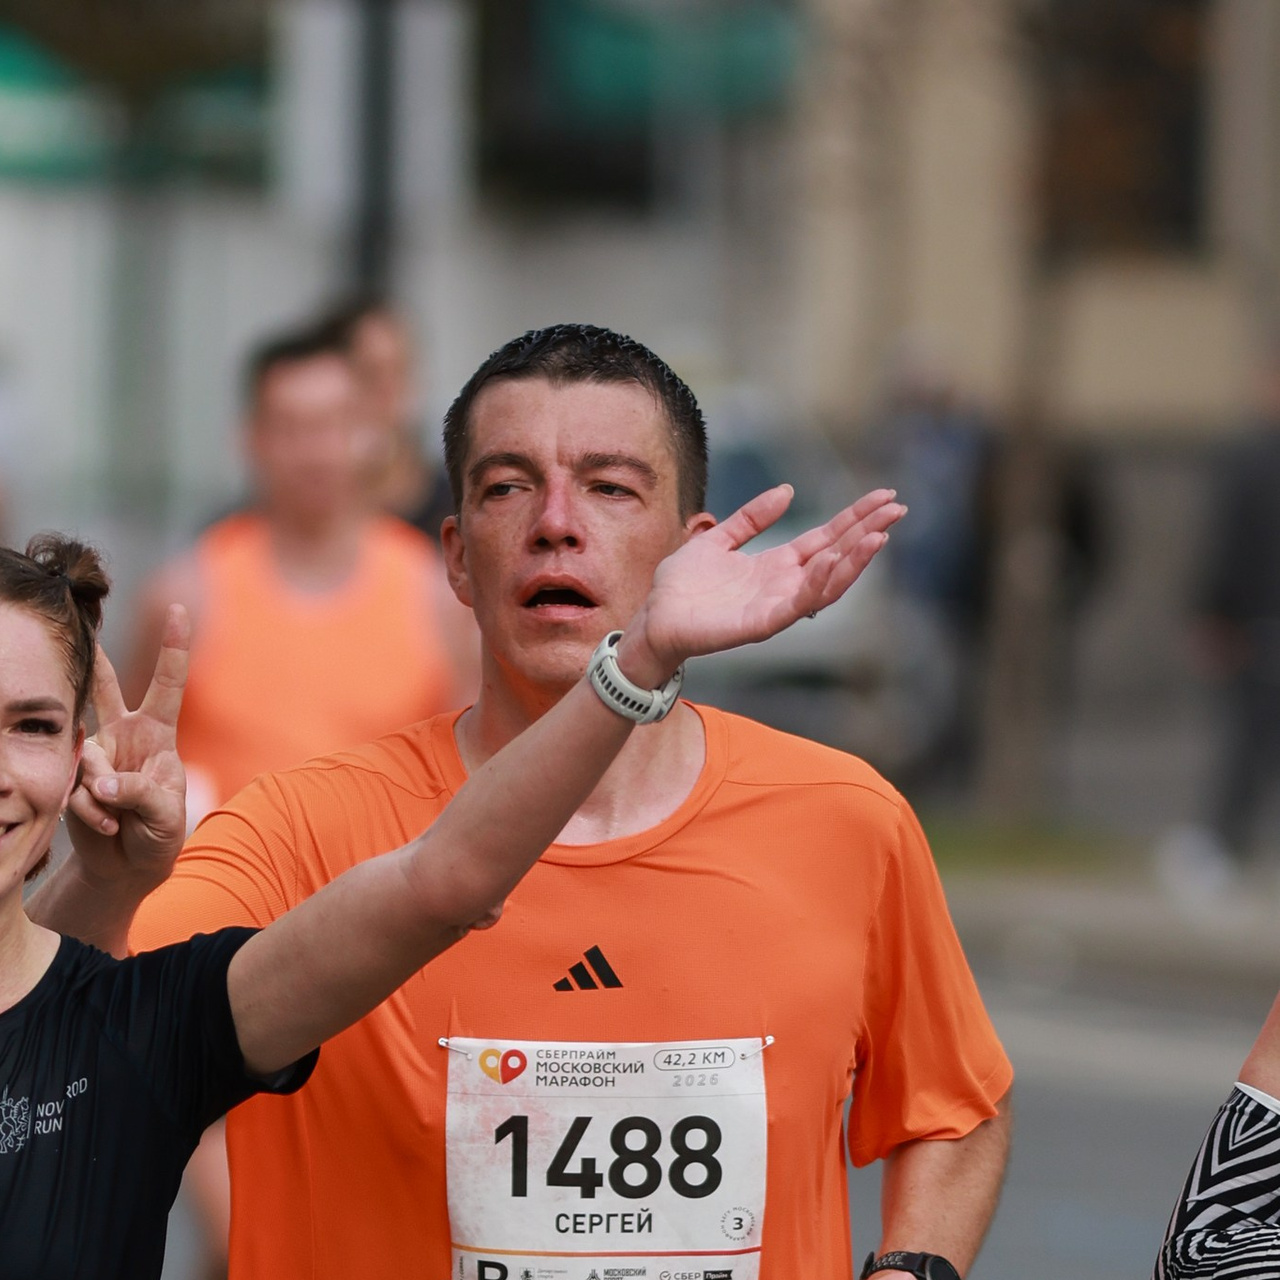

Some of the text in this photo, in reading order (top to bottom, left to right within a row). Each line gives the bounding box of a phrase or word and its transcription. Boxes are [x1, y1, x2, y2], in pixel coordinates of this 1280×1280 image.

[536, 1049, 617, 1060] СБЕРПРАЙМ
[663, 1053, 696, 1067] 42,2
[535, 1060, 645, 1074] МОСКОВСКИЙ
[535, 1075, 616, 1088] МАРАФОН
[34, 1116, 63, 1135] RUN
[495, 1115, 723, 1199] 1488
[555, 1207, 653, 1234] СЕРГЕЙ
[732, 1217, 744, 1230] 3
[603, 1266, 646, 1277] МОСКОВСКИЙ
[673, 1272, 701, 1280] СБЕР
